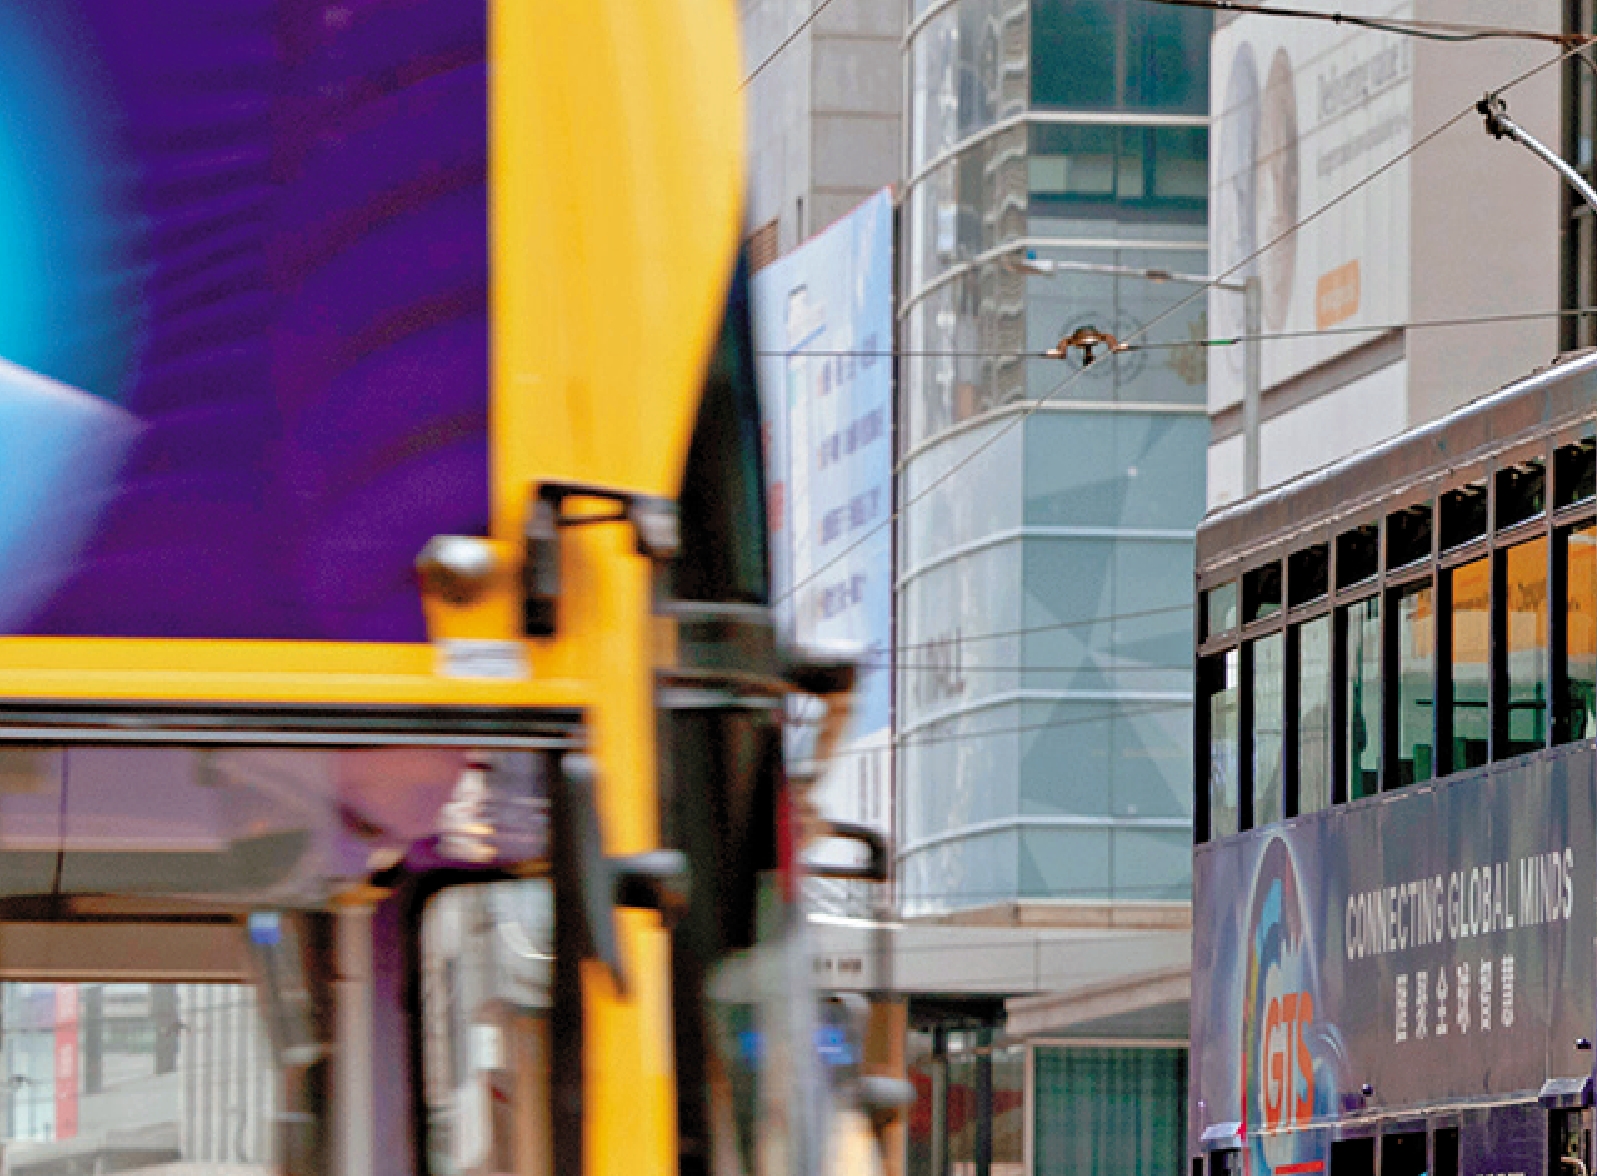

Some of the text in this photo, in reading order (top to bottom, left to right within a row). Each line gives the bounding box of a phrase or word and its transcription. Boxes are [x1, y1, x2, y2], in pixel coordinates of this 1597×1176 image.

[1345, 846, 1574, 960] CONNECTING GLOBAL MINDS
[1265, 991, 1314, 1138] GTS
